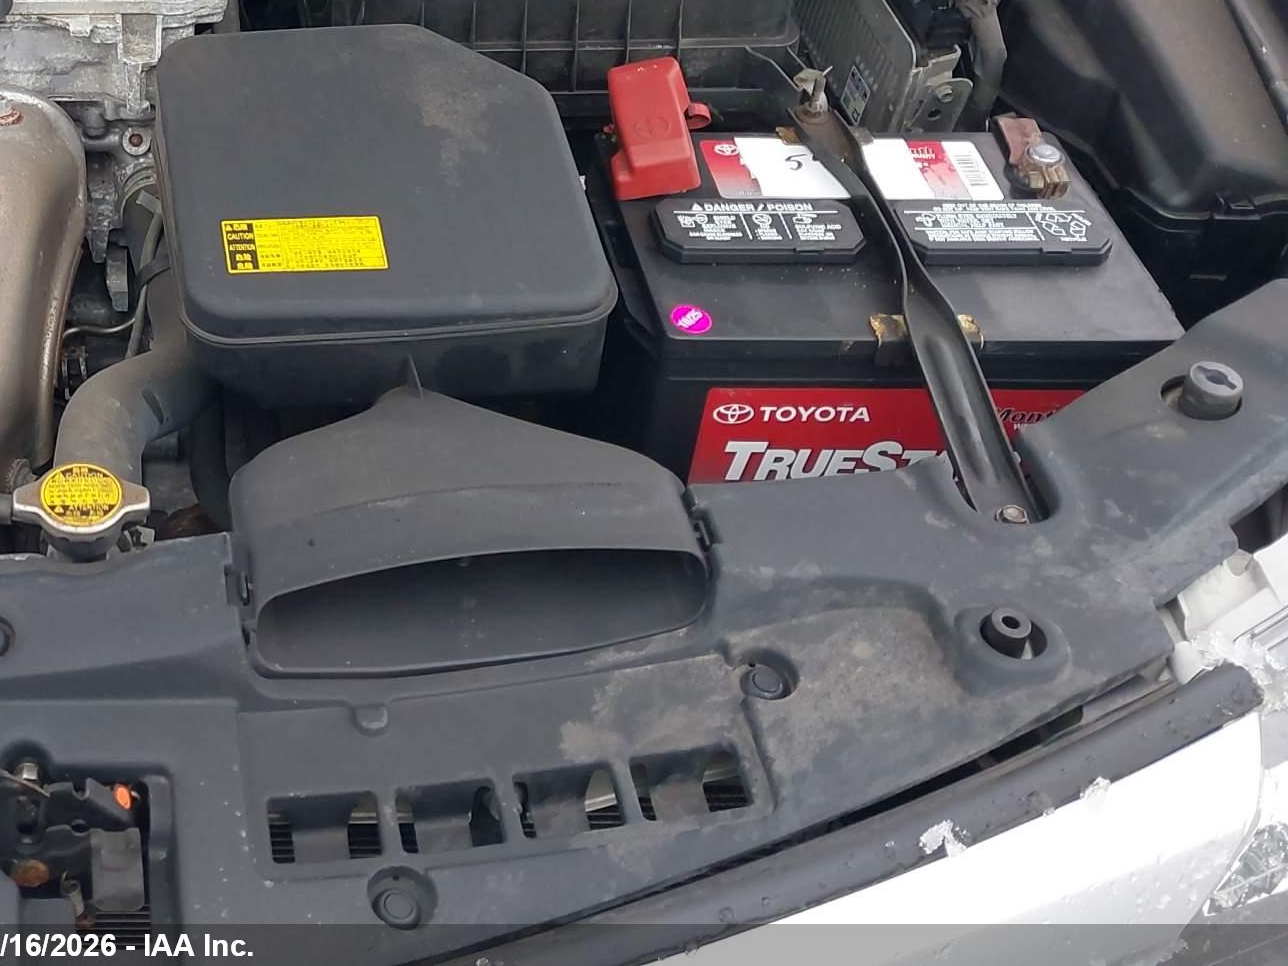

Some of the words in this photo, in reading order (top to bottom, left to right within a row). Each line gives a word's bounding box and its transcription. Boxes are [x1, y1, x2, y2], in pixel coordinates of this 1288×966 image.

[703, 202, 755, 212] DANGER
[767, 202, 814, 211] POISON
[227, 232, 254, 241] CAUTION
[760, 406, 871, 423] TOYOTA
